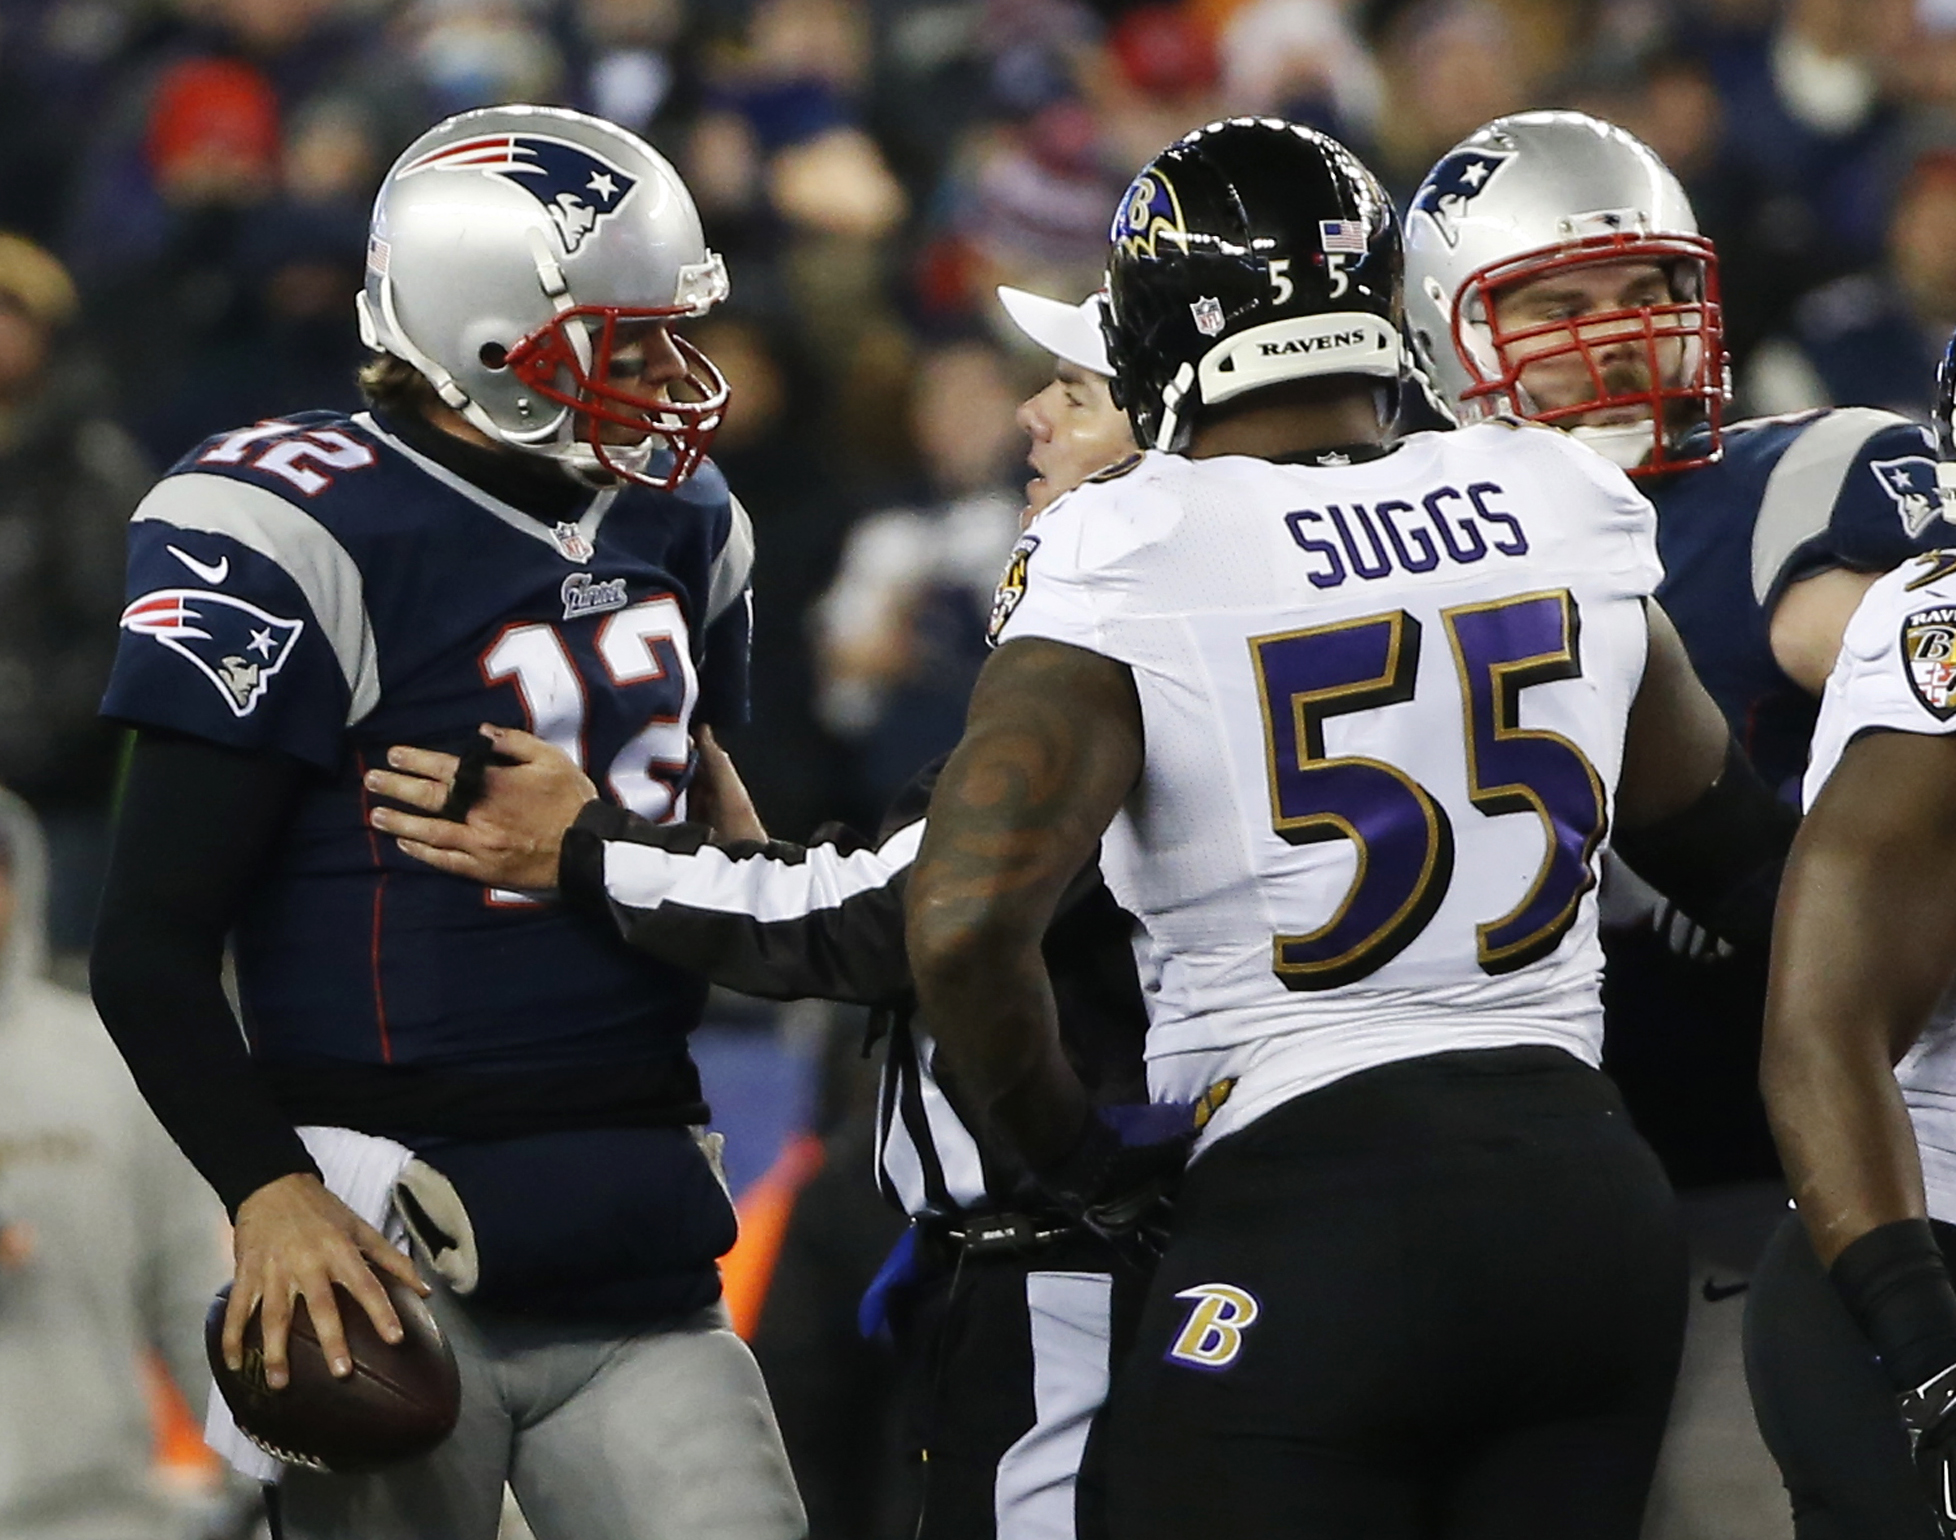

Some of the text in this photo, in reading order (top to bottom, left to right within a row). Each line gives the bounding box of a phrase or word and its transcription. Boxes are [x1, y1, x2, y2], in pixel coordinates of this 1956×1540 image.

[1268, 254, 1349, 305] 5 5
[1256, 328, 1365, 356] RAVENS
[196, 418, 379, 498] 12
[1284, 482, 1529, 590] SUGGS
[477, 592, 700, 908] 12
[1247, 588, 1608, 992] 55
[1165, 1281, 1261, 1373] B
